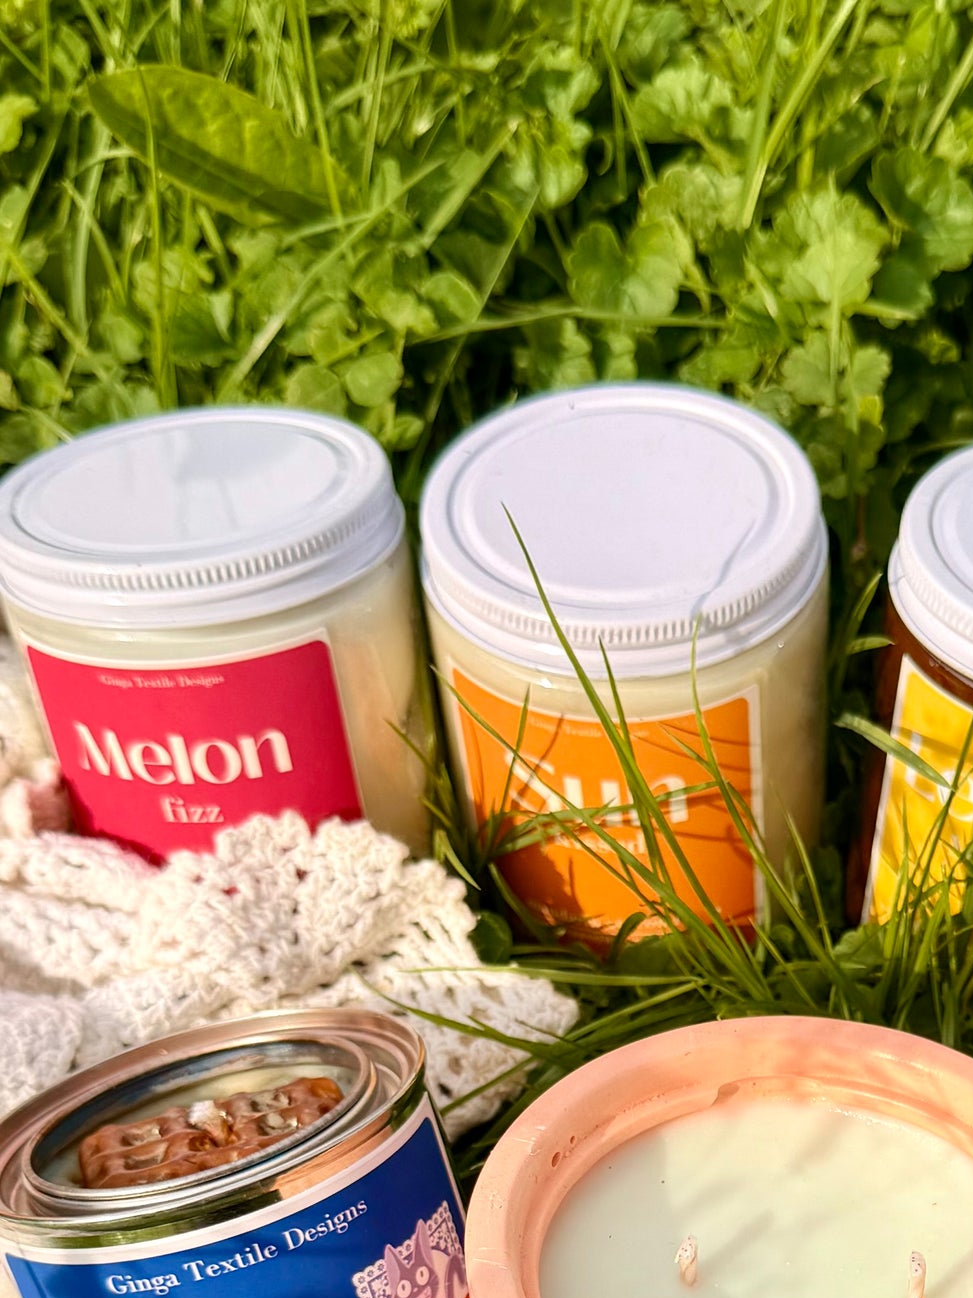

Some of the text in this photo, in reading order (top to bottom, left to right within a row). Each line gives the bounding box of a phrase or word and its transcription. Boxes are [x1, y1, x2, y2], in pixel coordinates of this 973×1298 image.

[73, 721, 294, 786] Melon
[159, 797, 225, 824] fizz
[105, 1199, 369, 1296] Ginga Textile Designs
